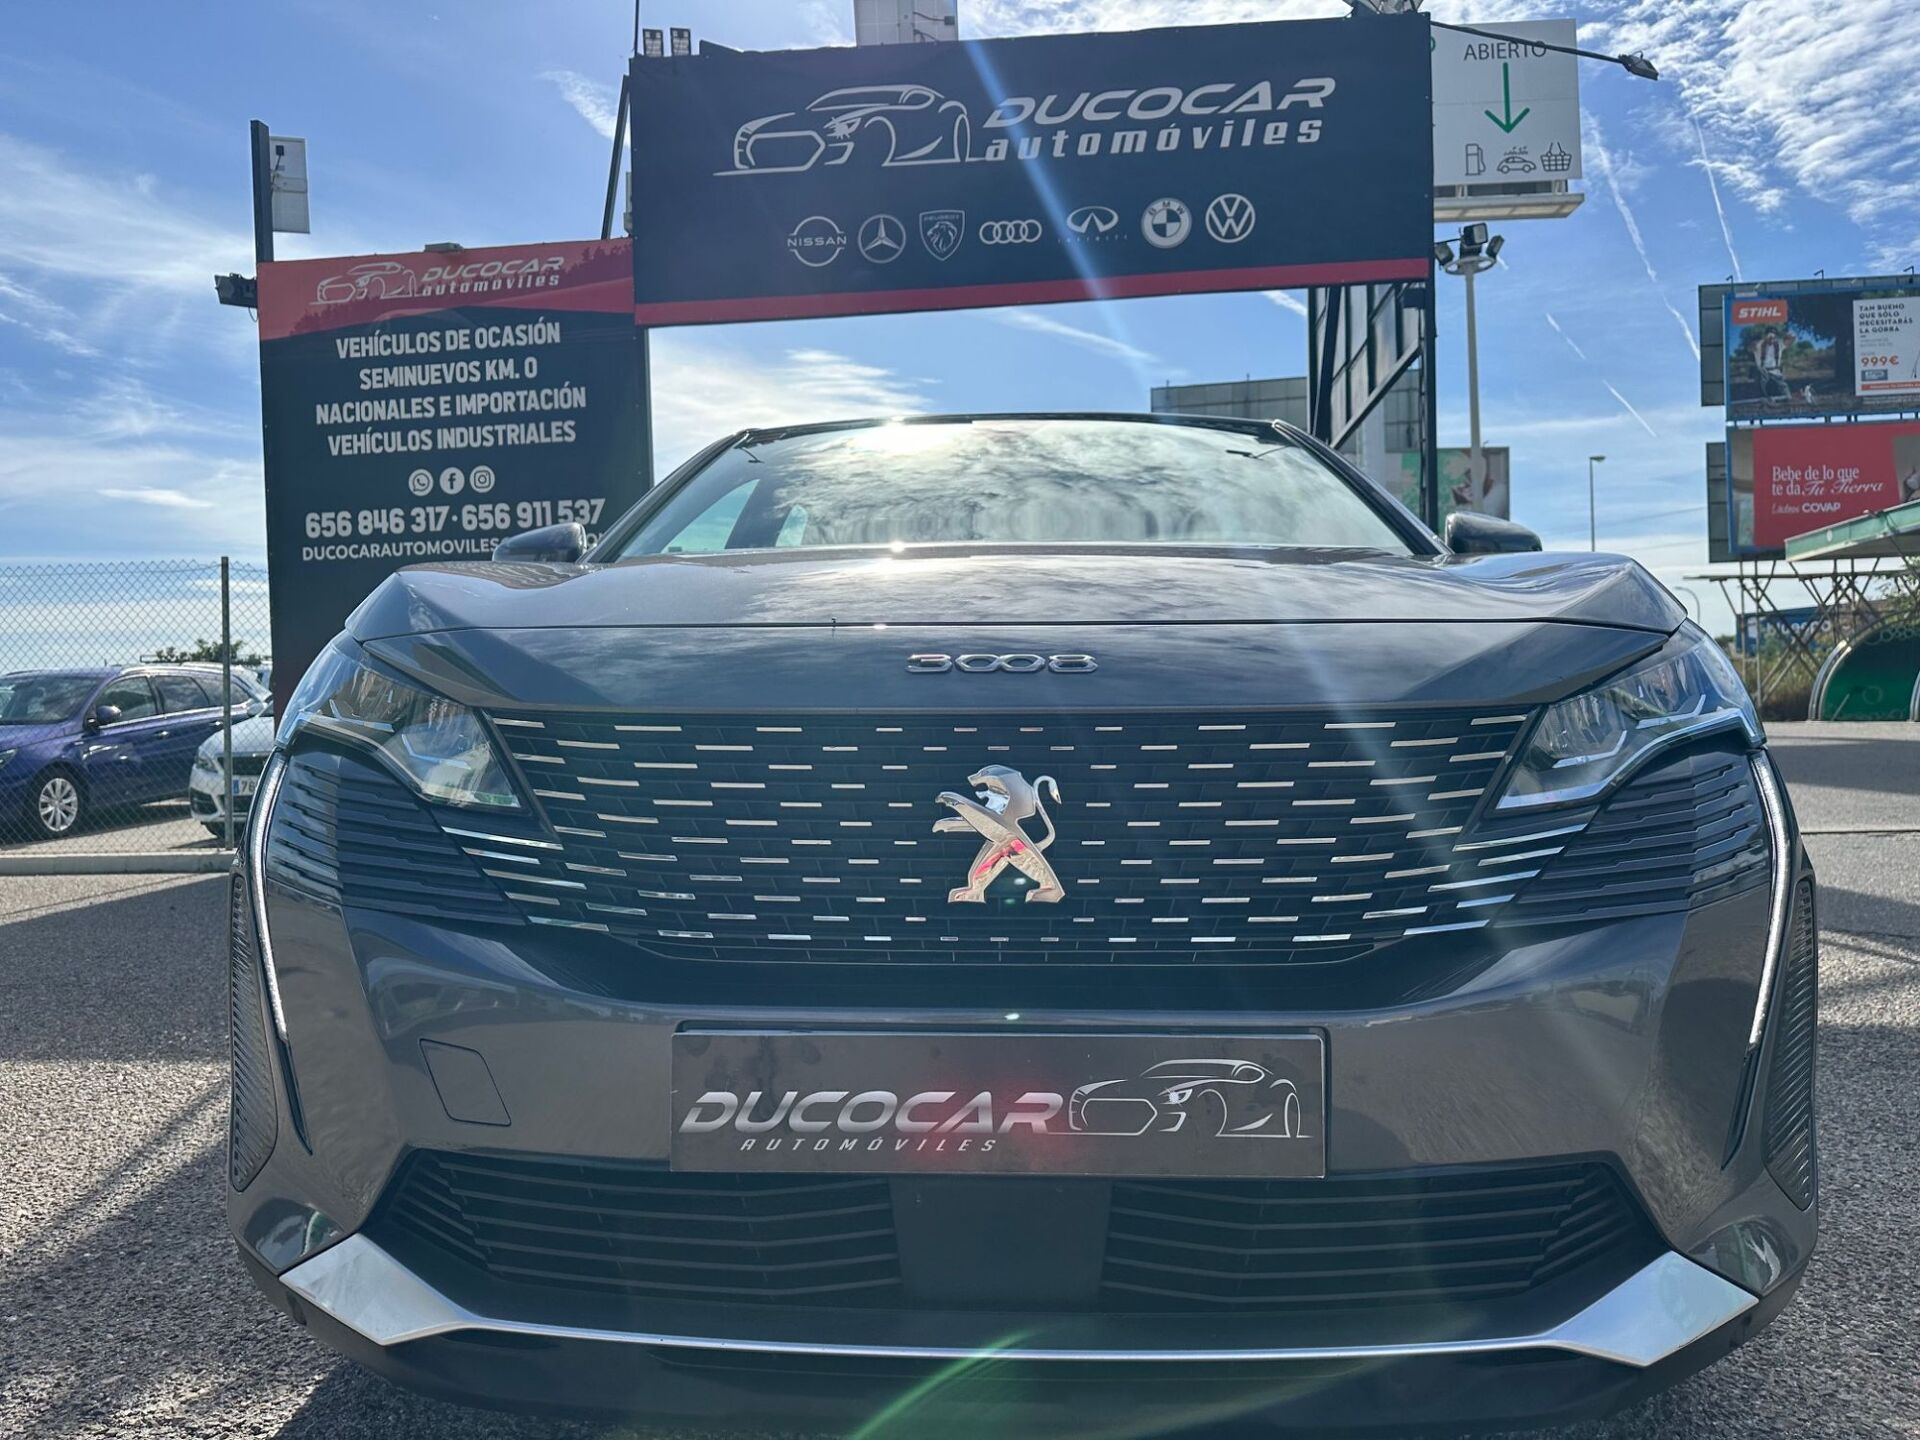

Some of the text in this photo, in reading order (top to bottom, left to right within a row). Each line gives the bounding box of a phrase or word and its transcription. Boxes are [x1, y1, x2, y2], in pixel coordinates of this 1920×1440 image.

[1464, 41, 1546, 60] ABIERTO
[983, 77, 1336, 128] DUCOCAR
[985, 119, 1322, 161] automóviles
[786, 236, 847, 248] NISSAN
[421, 257, 565, 282] DUCOCAR
[1739, 307, 1781, 319] STIHL
[336, 316, 561, 359] VEHÍCULOS DE OCASIÓN
[1861, 355, 1899, 367] 999€
[359, 361, 480, 390] SEMINUEVOS
[486, 359, 520, 380] KM.
[316, 382, 586, 425] NACIONALES E IMPORTACIÓN
[328, 420, 576, 456] VEHÍCULOS INDUSTRIALES
[1772, 464, 1860, 483] Bebe de lo que
[1772, 483, 1783, 496] te
[305, 498, 606, 538] 656 846 317 656 911 537
[1801, 502, 1841, 513] COVAP
[302, 537, 508, 561] DUCOCARAUTOMOVILES
[907, 654, 1098, 673] 3008
[679, 1090, 1064, 1134] DUCOCAR
[740, 1137, 997, 1153] AUTOMÓVILES
